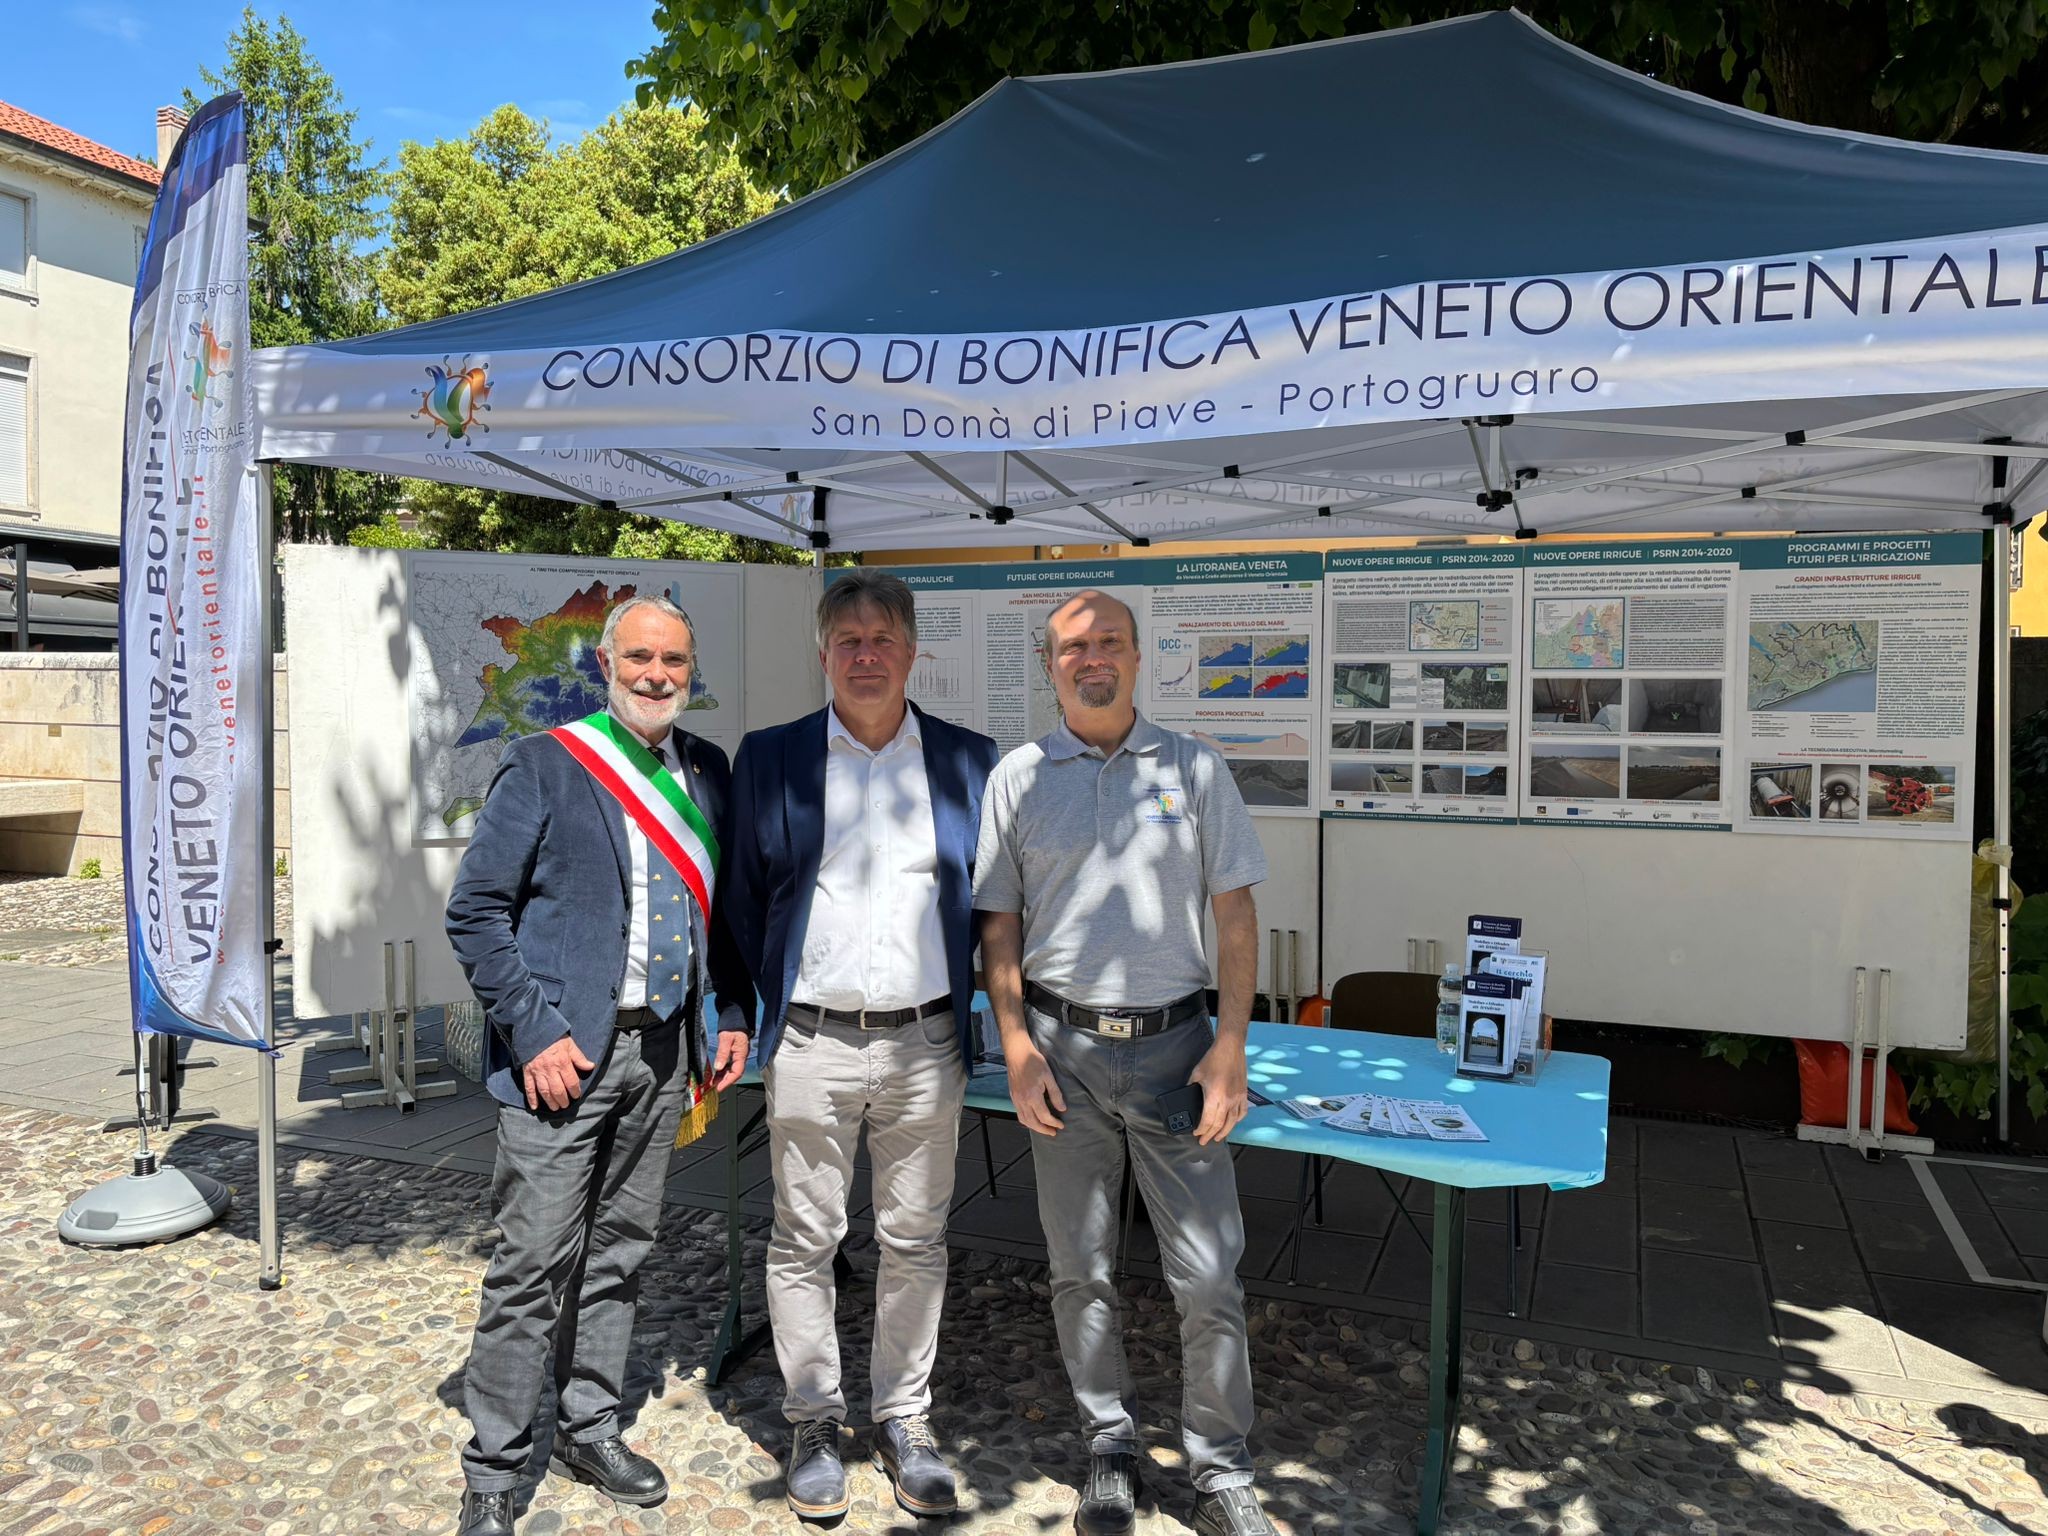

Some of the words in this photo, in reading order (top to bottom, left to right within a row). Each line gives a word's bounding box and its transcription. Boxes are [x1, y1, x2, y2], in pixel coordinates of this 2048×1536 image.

[542, 334, 862, 391] CONSORZIO
[882, 338, 940, 385] DI
[957, 319, 1262, 385] BONIFICA
[1289, 277, 1574, 354] VENETO
[1604, 244, 2048, 331] ORIENTALE
[811, 405, 880, 437] San
[902, 406, 1011, 439] Donà
[1033, 405, 1070, 439] di
[1094, 398, 1217, 434] Piave
[1279, 365, 1600, 415] Portogruaro
[1787, 542, 1860, 553] PROGRAMMI
[1863, 542, 1871, 551] E
[1873, 540, 1931, 550] PROGETTI
[1332, 558, 1363, 567] NUOVE
[1364, 557, 1395, 566] OPERE
[1396, 556, 1433, 565] IRRIGUE
[1442, 554, 1467, 564] PSRN
[1468, 553, 1515, 563] 2014-2020
[1533, 552, 1567, 561] NUOVE
[1568, 551, 1601, 560] OPERE
[1603, 550, 1642, 559] IRRIGUE
[1652, 549, 1680, 558] PSRN
[1681, 547, 1733, 557] 2014-2020
[1787, 555, 1825, 564] FUTURI
[1828, 554, 1849, 563] PER
[1851, 552, 1931, 563] L'IRRIGAZIONE
[1176, 563, 1189, 573] LA
[1190, 561, 1247, 572] LITORANEA
[1248, 559, 1288, 570] VENETA
[908, 575, 954, 584] IDRAULICHE
[1007, 573, 1037, 582] FUTURE
[1038, 572, 1065, 581] OPERE
[1066, 570, 1115, 580] IDRAULICHE
[1794, 575, 1823, 583] GRANDI
[1824, 574, 1889, 582] INFRASTRUTTURE
[1890, 573, 1922, 581] IRRIGUE
[1158, 636, 1181, 651] ipcc
[170, 775, 219, 964] VENETO
[1504, 969, 1534, 978] cerchio
